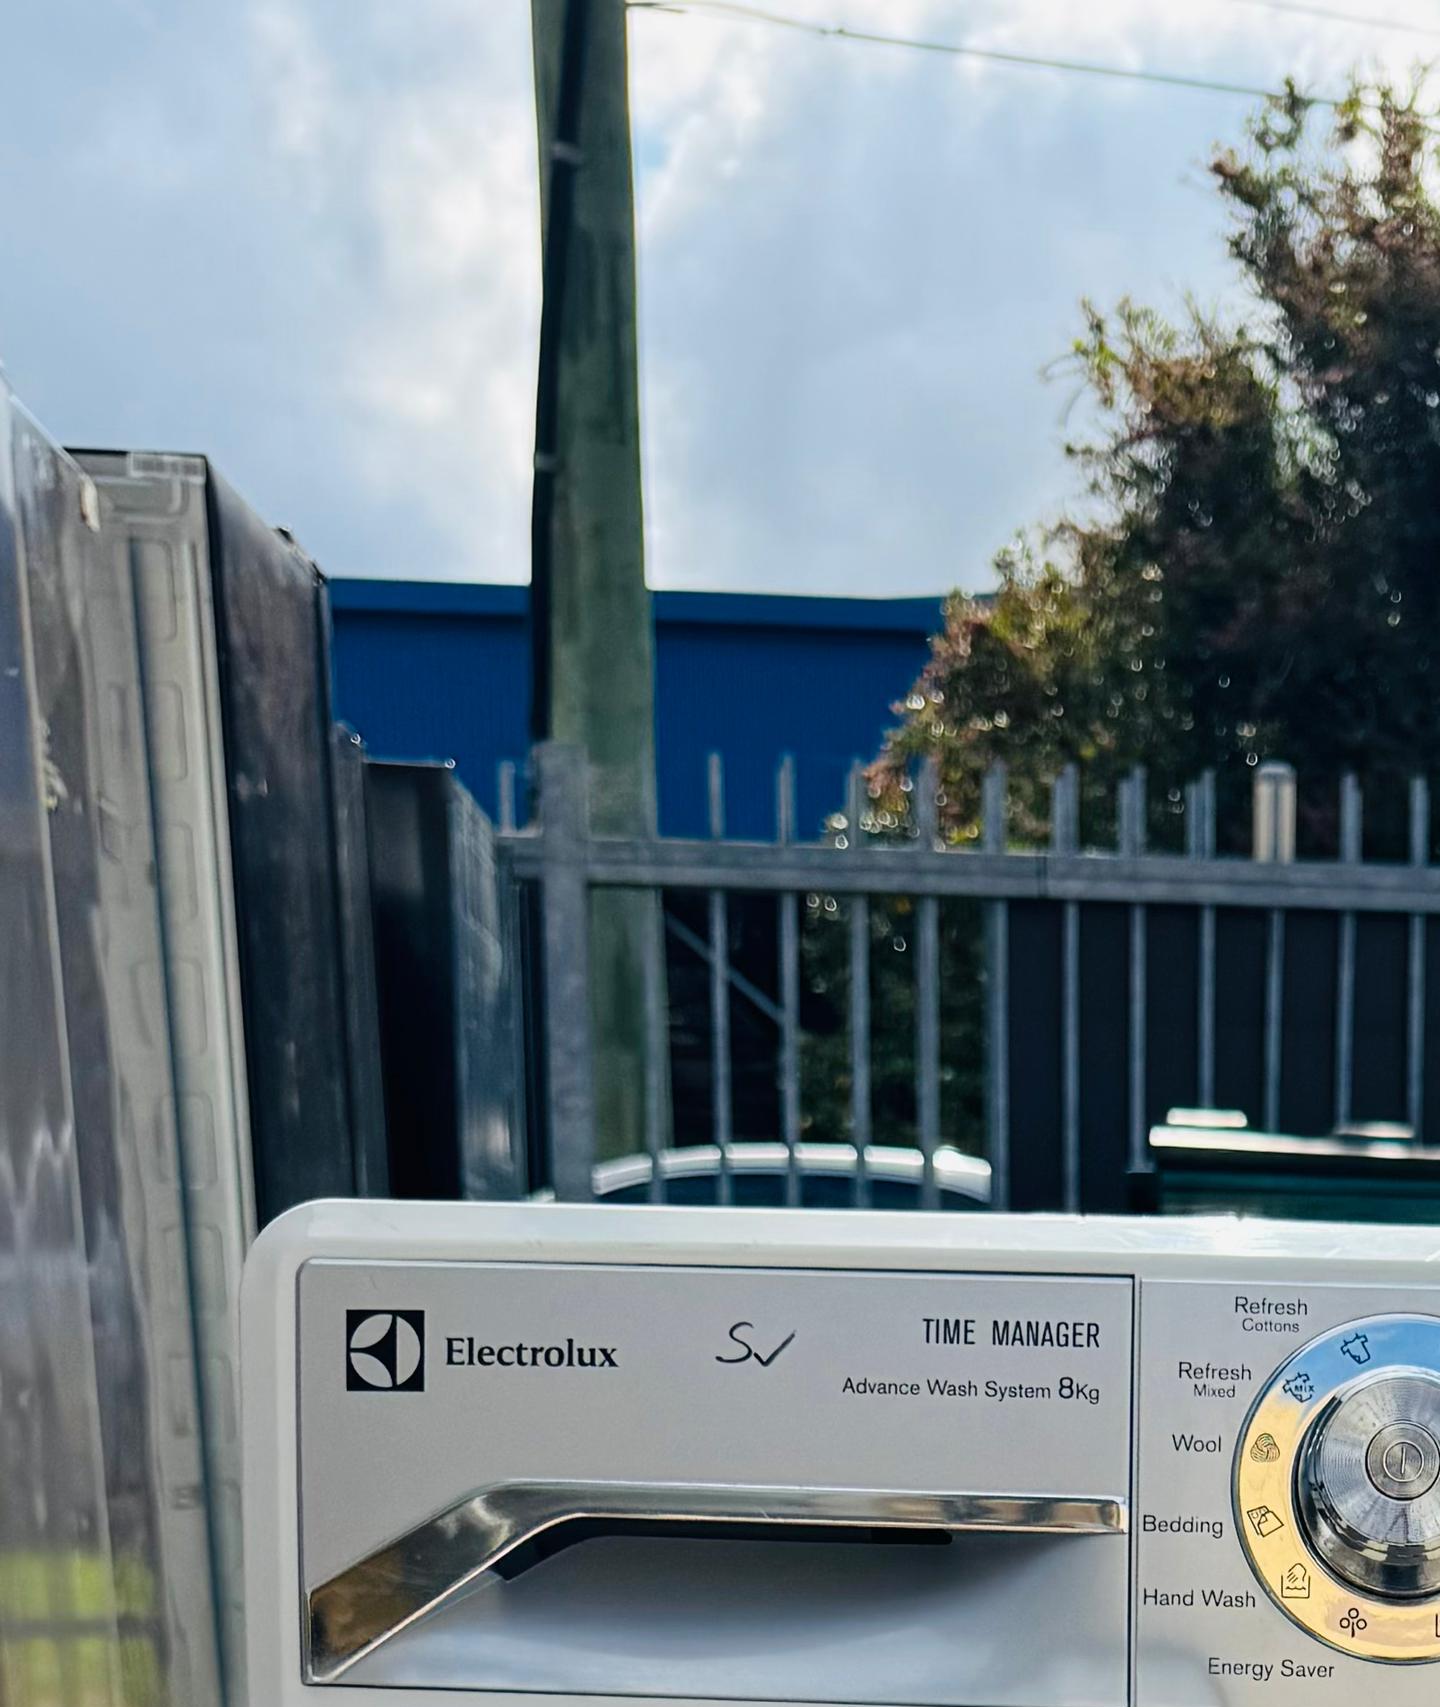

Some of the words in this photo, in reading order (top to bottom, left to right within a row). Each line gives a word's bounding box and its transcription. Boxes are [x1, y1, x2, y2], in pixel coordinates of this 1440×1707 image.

[1234, 1297, 1308, 1316] Refresh
[922, 1318, 976, 1346] TIME
[992, 1319, 1101, 1348] MANAGER
[1242, 1318, 1300, 1333] Cottons
[445, 1336, 619, 1368] Electrolux
[1178, 1362, 1251, 1381] Refresh
[842, 1377, 920, 1398] Advance
[926, 1379, 978, 1399] Wash
[984, 1378, 1051, 1402] System
[1058, 1377, 1100, 1404] 8Kg
[1193, 1384, 1236, 1399] Mixed
[1172, 1434, 1222, 1453] Wool
[1142, 1515, 1224, 1538] Bedding
[1142, 1588, 1194, 1607] Hand
[1201, 1589, 1256, 1609] Wash
[1207, 1657, 1274, 1682] Energy
[1280, 1660, 1335, 1679] Saver
